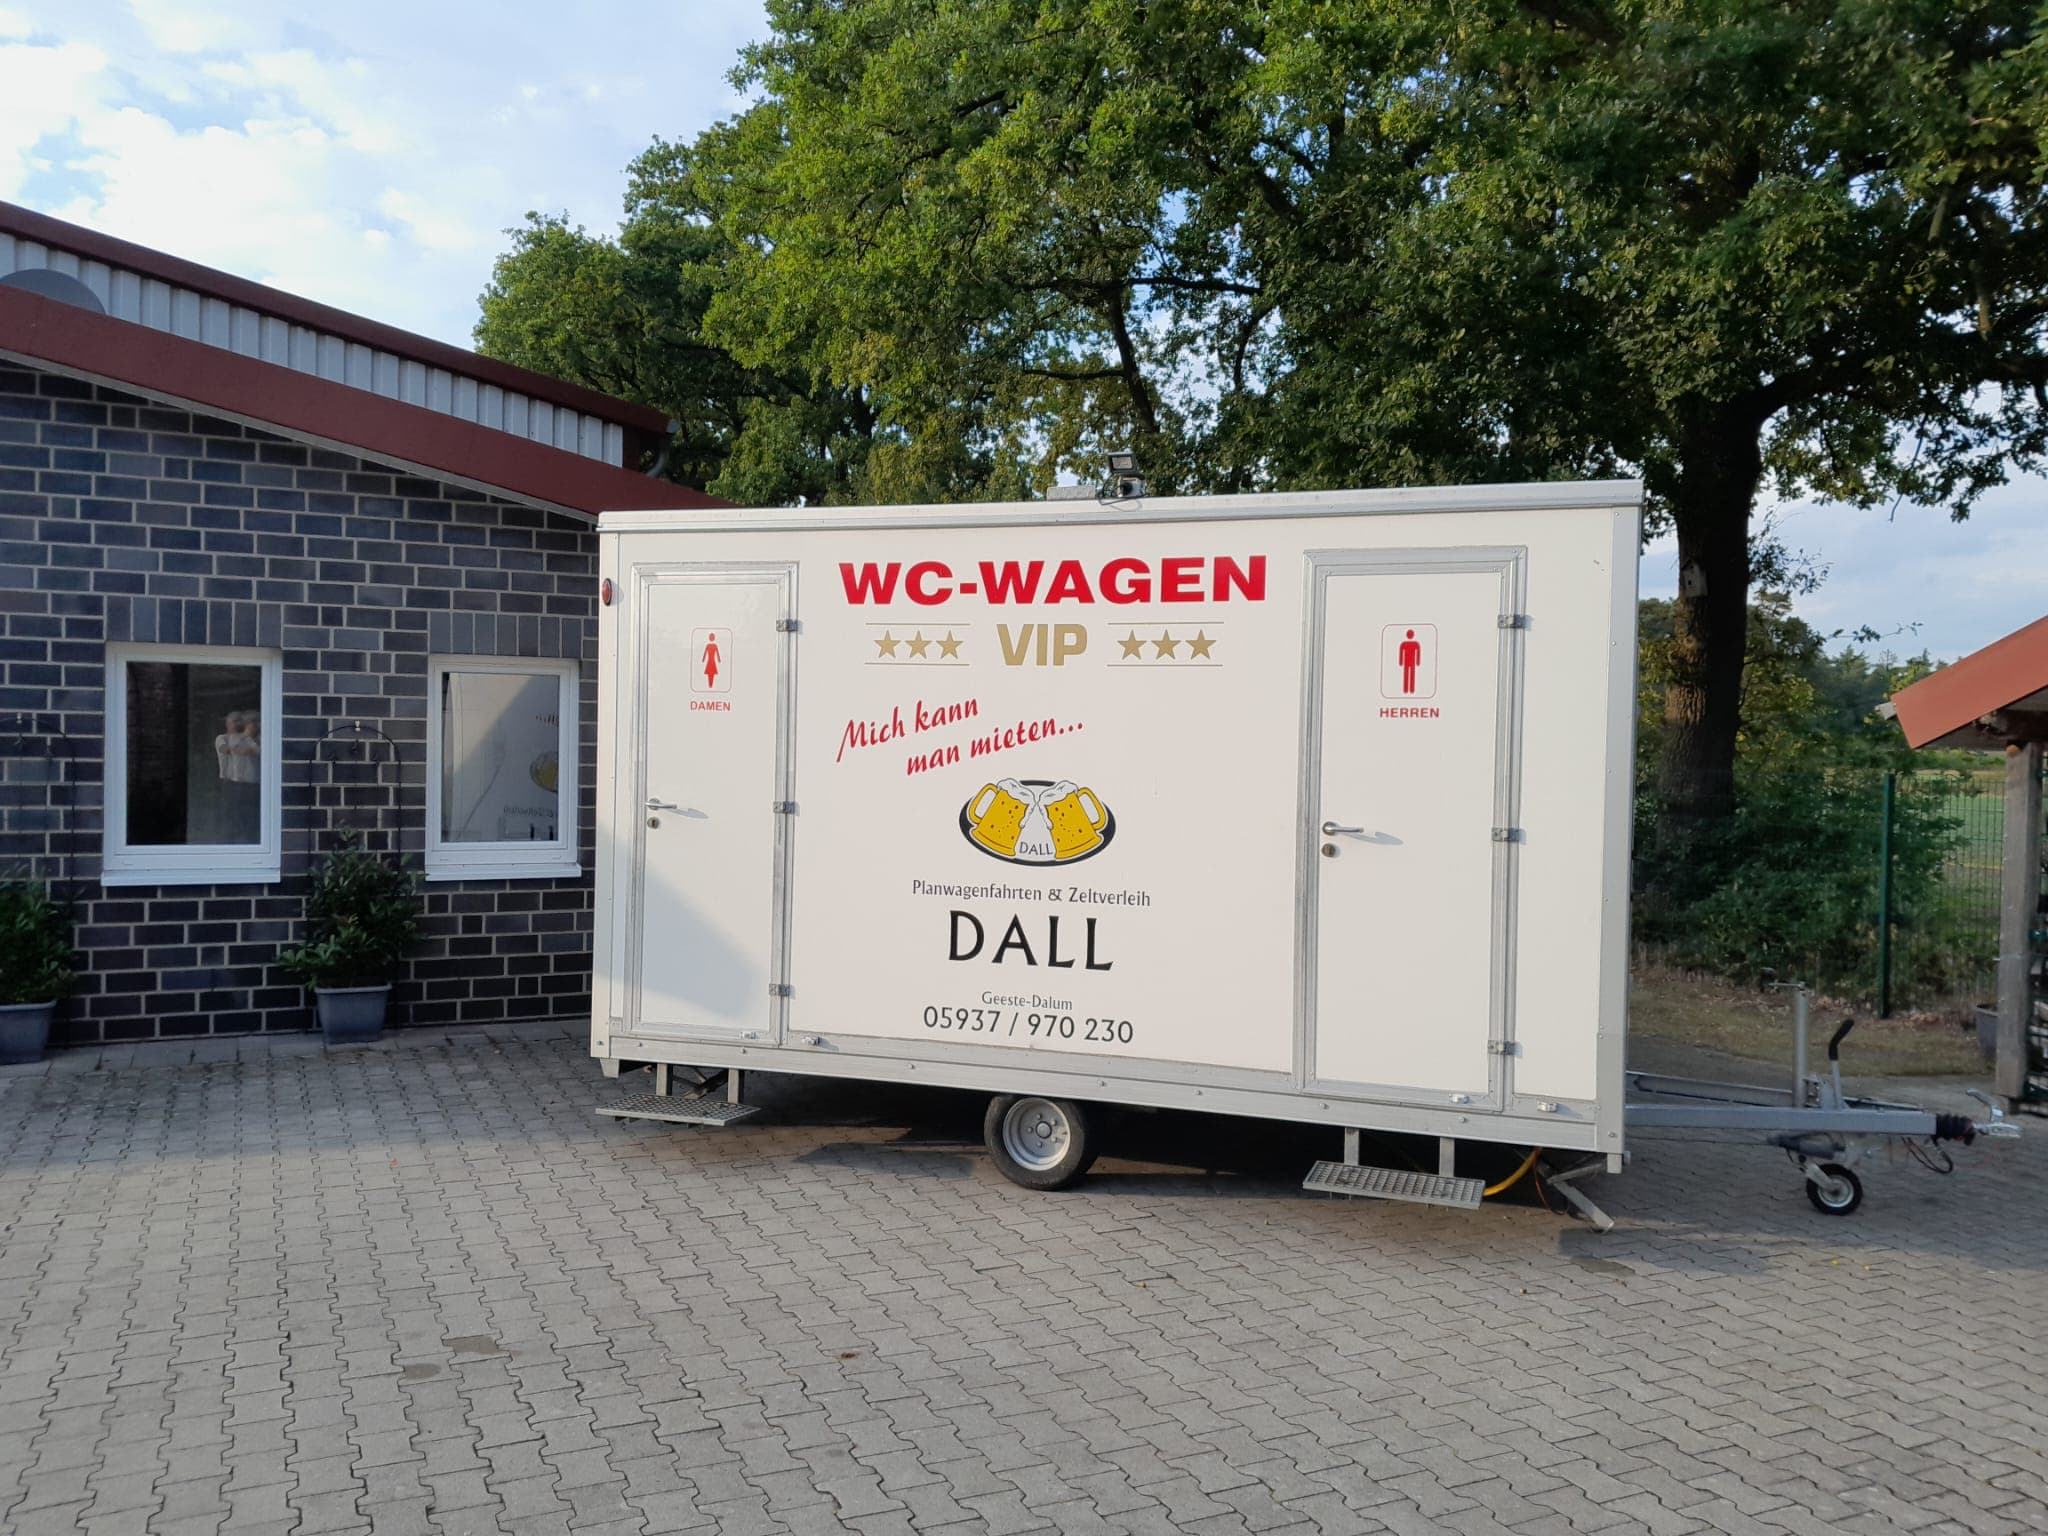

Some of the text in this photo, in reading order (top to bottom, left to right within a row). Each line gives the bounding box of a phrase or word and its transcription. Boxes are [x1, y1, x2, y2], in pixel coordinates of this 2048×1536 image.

[839, 555, 1267, 606] WC-WAGEN
[997, 623, 1088, 667] VIP
[690, 701, 731, 711] DAMEN
[1379, 707, 1440, 718] HERREN
[836, 698, 979, 762] Mich kann
[907, 745, 961, 776] man
[1019, 841, 1053, 856] DALL
[912, 879, 1151, 907] Planwagenfahrten & Zeltverleih
[948, 910, 1113, 971] DALL
[981, 991, 1073, 1010] Geeste-Dalum
[923, 1005, 1134, 1044] 05937 / 970 230
